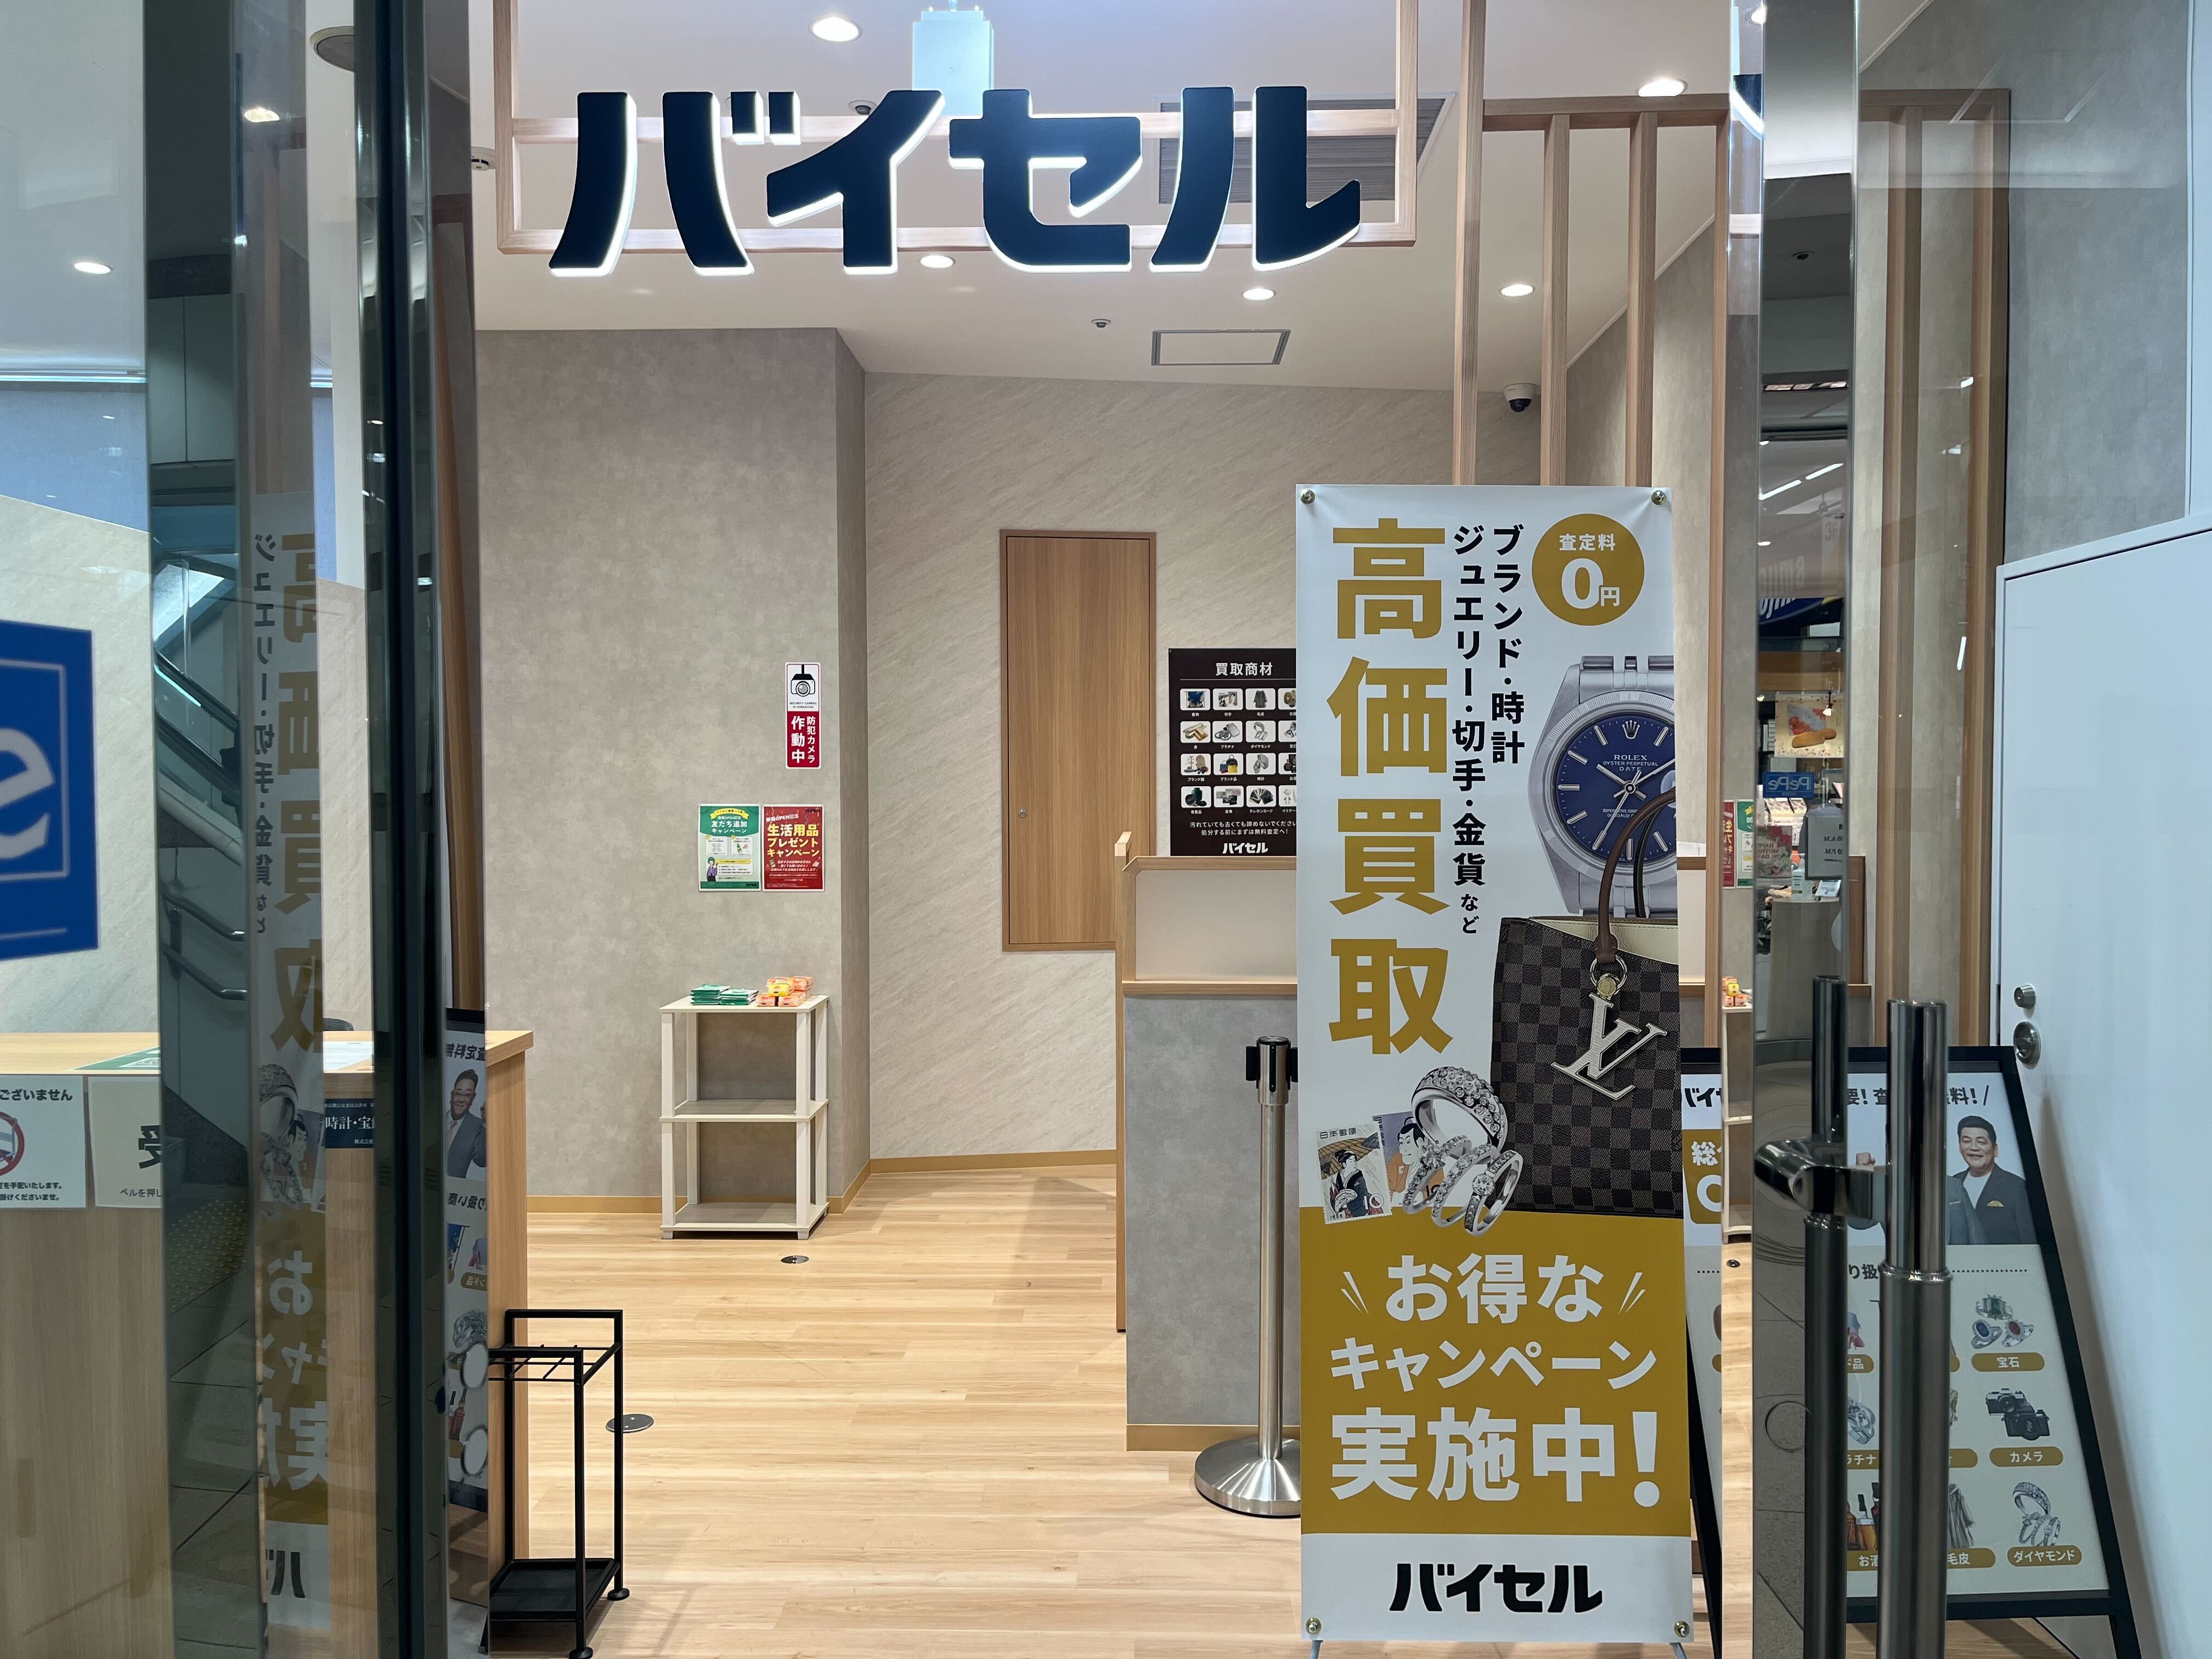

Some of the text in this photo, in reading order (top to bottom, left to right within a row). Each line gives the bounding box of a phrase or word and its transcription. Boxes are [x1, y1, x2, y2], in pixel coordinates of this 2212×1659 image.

[550, 87, 1361, 274] バイセル
[1559, 533, 1616, 551] 査定料
[1561, 558, 1620, 609] 0円
[1491, 523, 1525, 764] ブランド・時計
[1215, 662, 1273, 676] 買取商材
[791, 715, 805, 764] 作動中
[806, 716, 816, 764] 防犯カメラ
[1452, 524, 1486, 933] ジュエリー・切手・金貨など
[1327, 518, 1453, 1054] 高価買取
[767, 823, 819, 837] 生活用品
[768, 837, 819, 848] プレゼント
[767, 848, 820, 857] キャンペーン
[1222, 842, 1268, 854] バイセル
[325, 1116, 375, 1130] 時計・宝
[1320, 1127, 1357, 1139] 日本郵便
[1691, 1141, 1722, 1166] 総
[1385, 1252, 1604, 1324] お得な
[1330, 1337, 1657, 1392] キャンペーン
[1996, 1356, 2019, 1368] 宝石
[1330, 1407, 1660, 1508] 実施中!
[2010, 1451, 2044, 1463] カメラ
[2013, 1549, 2074, 1563] ダイヤモンド
[1389, 1563, 1603, 1612] バイセル
